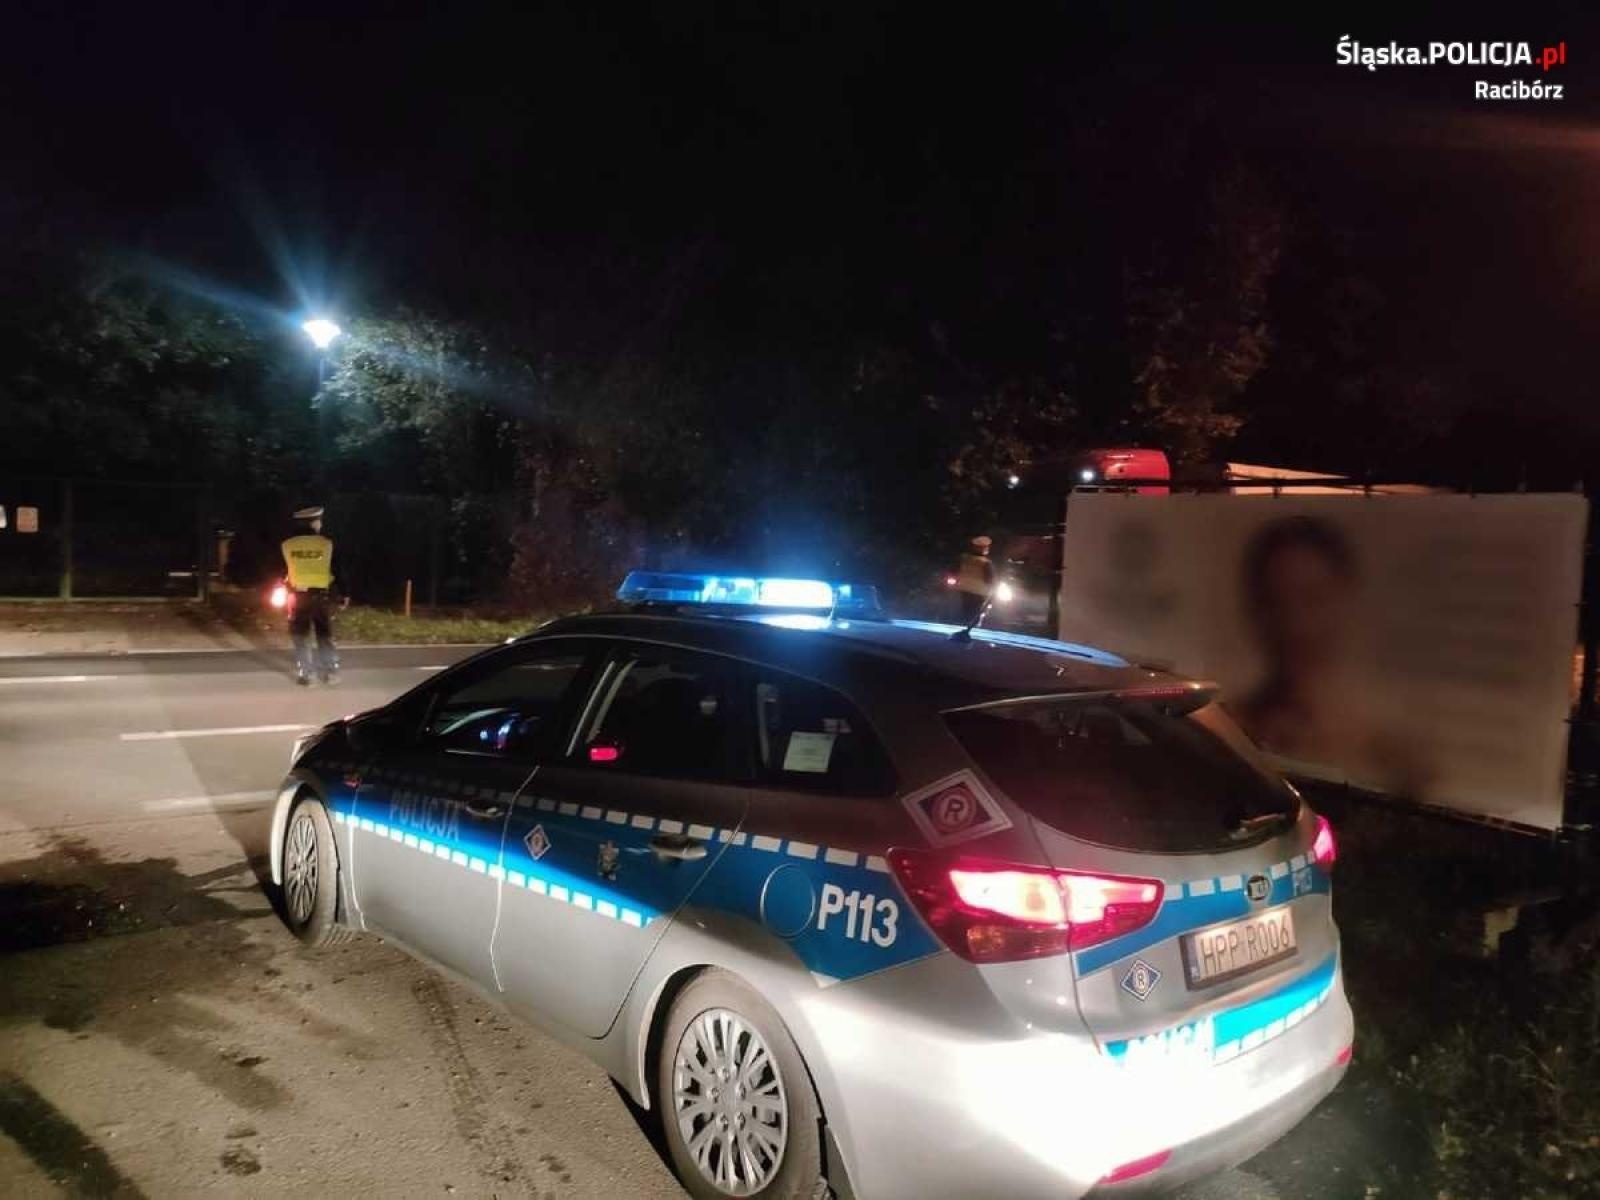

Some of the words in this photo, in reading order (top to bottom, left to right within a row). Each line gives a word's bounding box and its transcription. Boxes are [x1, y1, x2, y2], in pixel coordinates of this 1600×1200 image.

[389, 789, 460, 841] POLICJA
[817, 883, 899, 947] P113
[1201, 930, 1238, 976] HPP
[1246, 915, 1289, 961] R006
